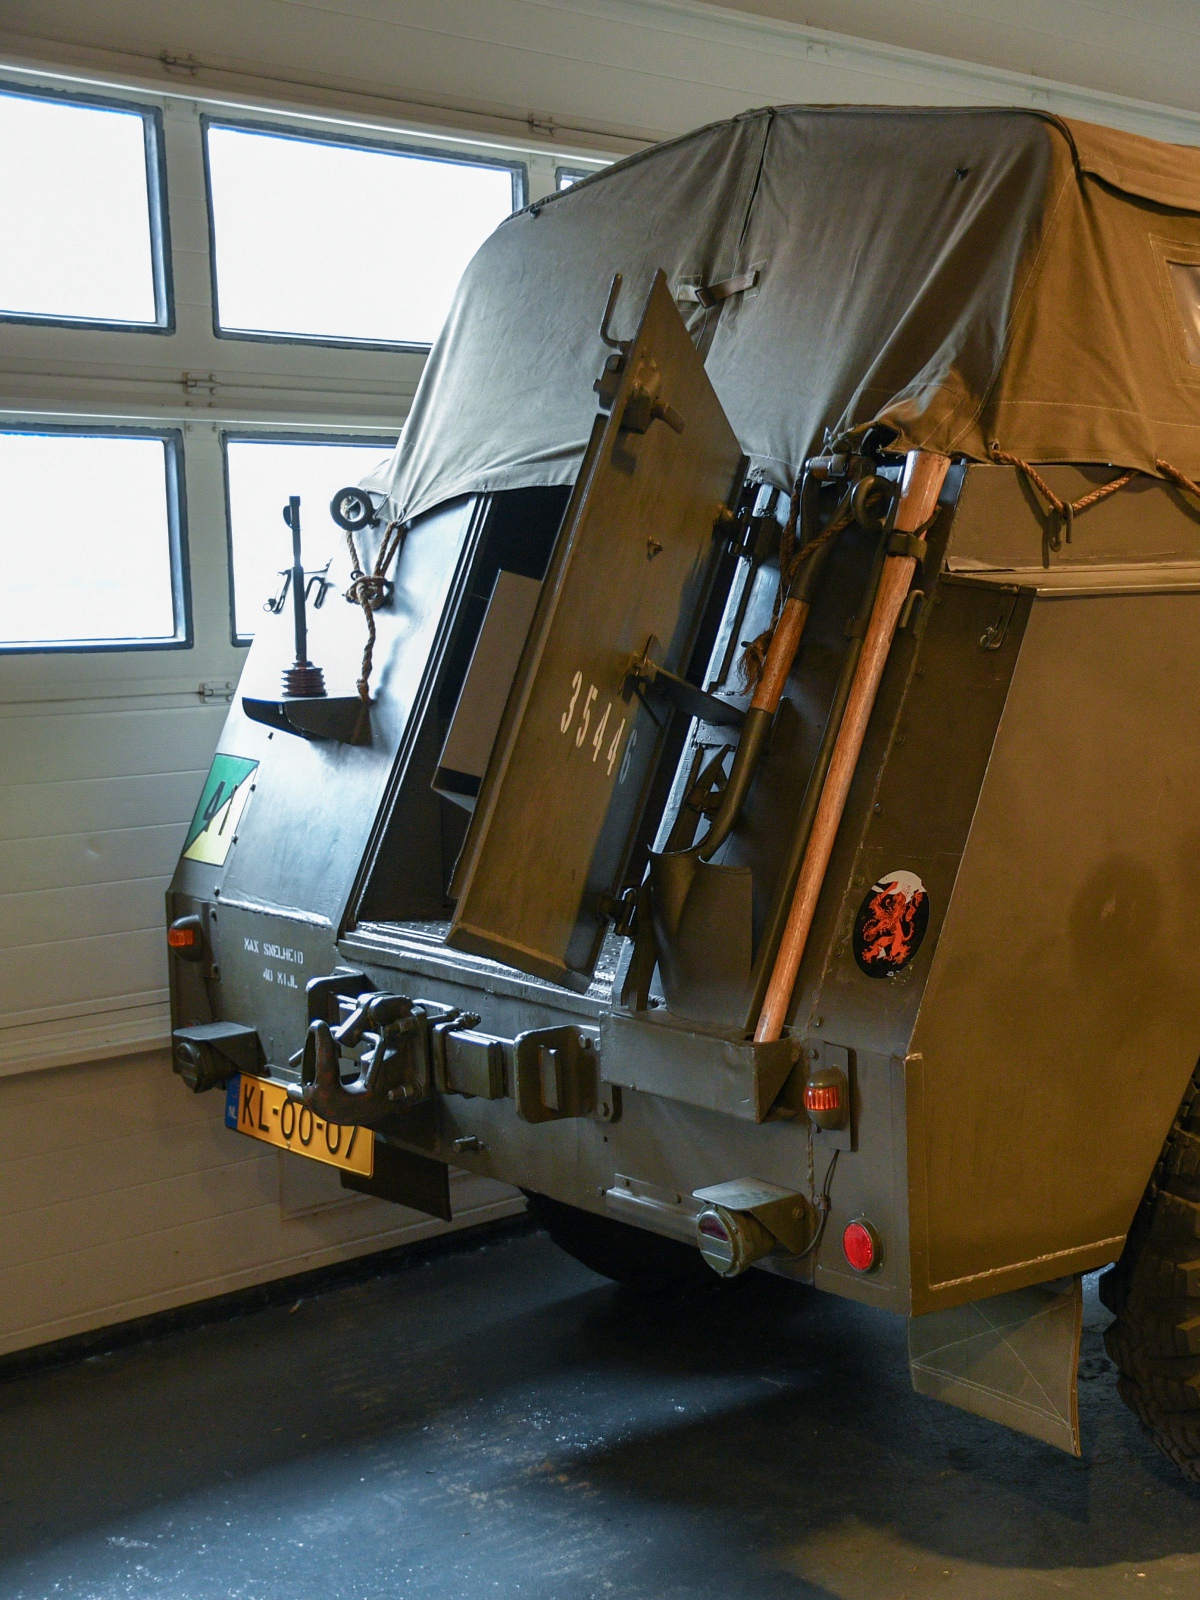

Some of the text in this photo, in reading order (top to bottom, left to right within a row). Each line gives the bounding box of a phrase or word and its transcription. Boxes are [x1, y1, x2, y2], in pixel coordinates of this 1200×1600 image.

[560, 670, 638, 786] 35446
[243, 937, 304, 965] MAX SNELHEID
[263, 967, 274, 982] 40
